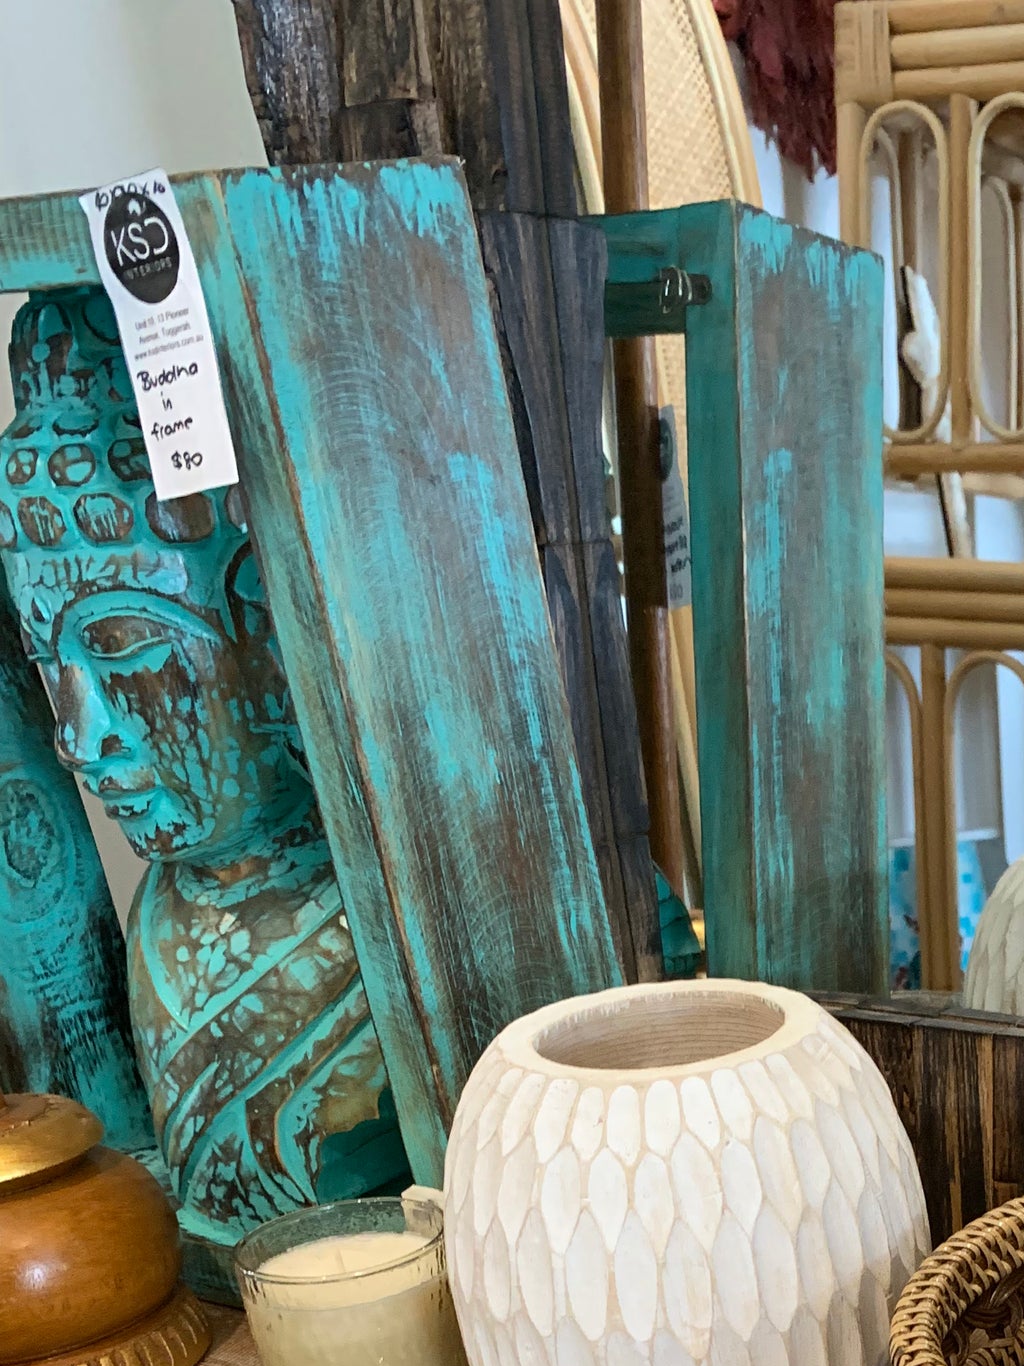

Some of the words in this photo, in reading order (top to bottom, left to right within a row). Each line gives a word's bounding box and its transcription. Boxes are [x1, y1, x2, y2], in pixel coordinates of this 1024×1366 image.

[137, 362, 198, 391] Buddha
[160, 391, 173, 412] in
[151, 416, 193, 441] frame
[171, 450, 203, 470] $80
